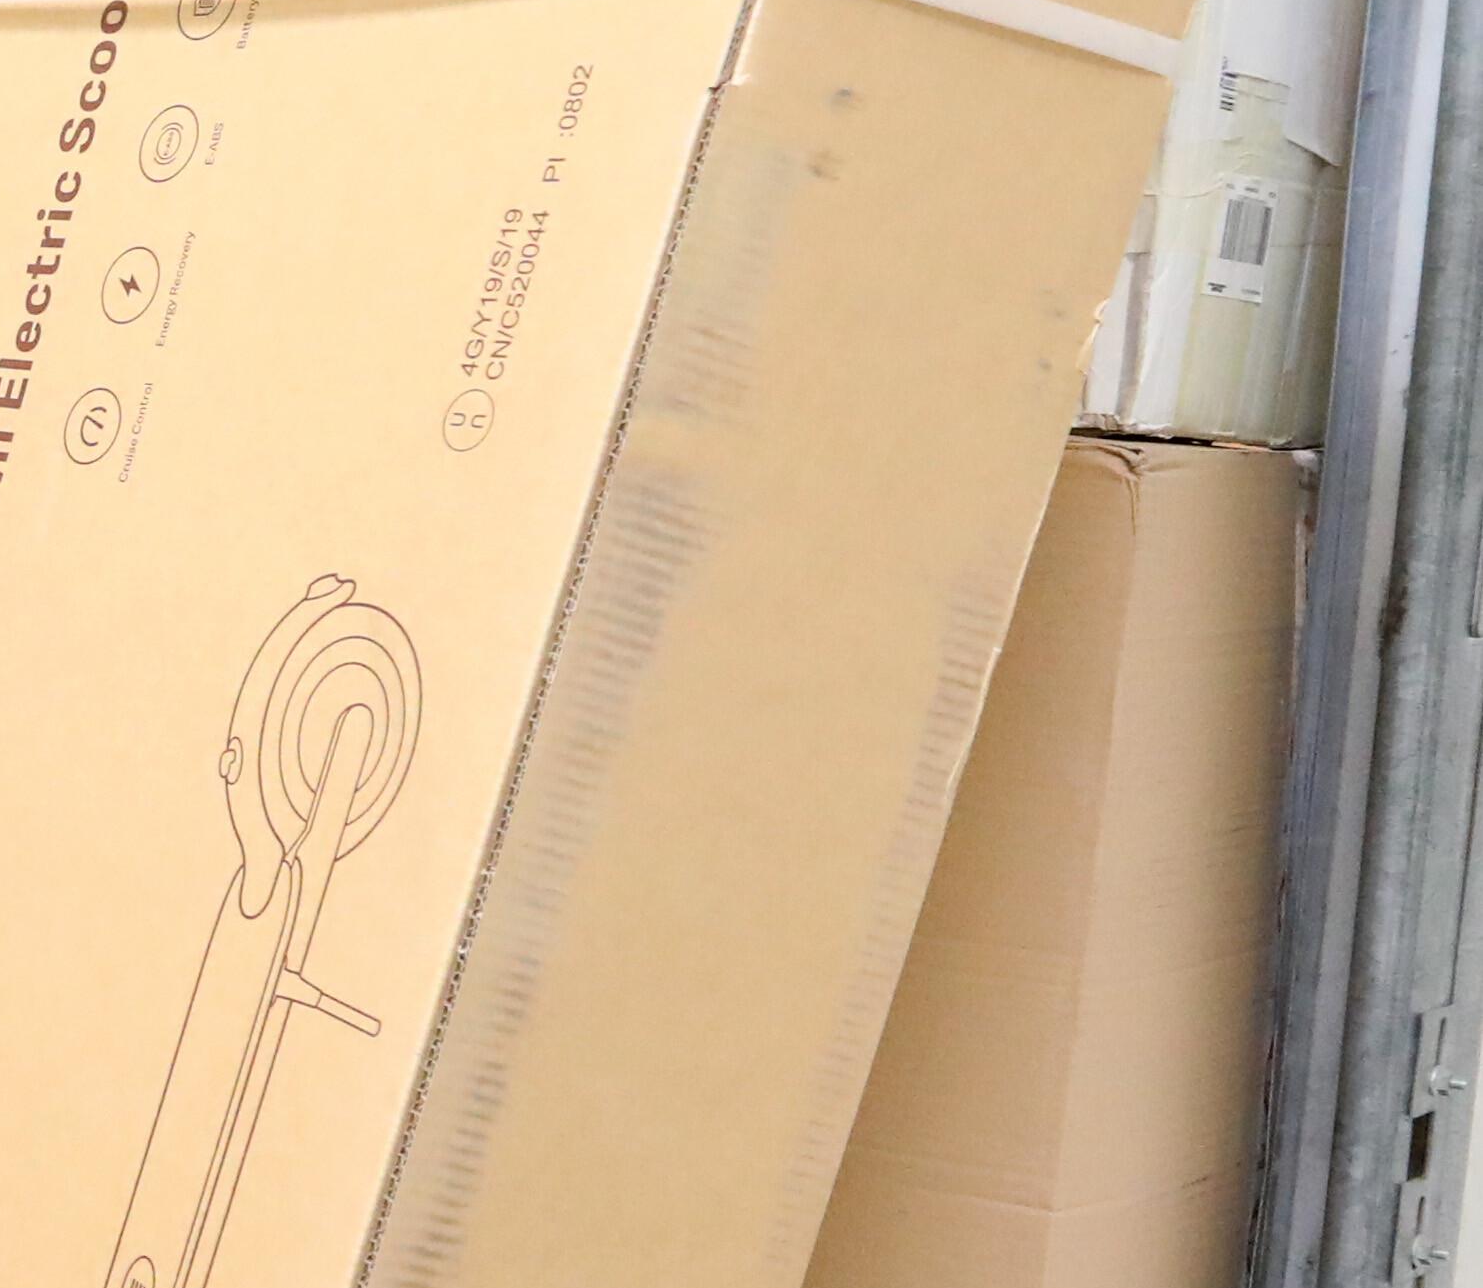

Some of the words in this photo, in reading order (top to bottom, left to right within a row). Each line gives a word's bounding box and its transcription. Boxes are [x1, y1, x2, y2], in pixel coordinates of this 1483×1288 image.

[236, 0, 262, 50] Battery
[204, 121, 224, 166] E-ABS
[155, 299, 178, 347] Energy
[169, 231, 196, 296] Recovery
[485, 210, 550, 380] CN/C520044
[118, 437, 140, 484] Cruise
[131, 382, 154, 435] Control
